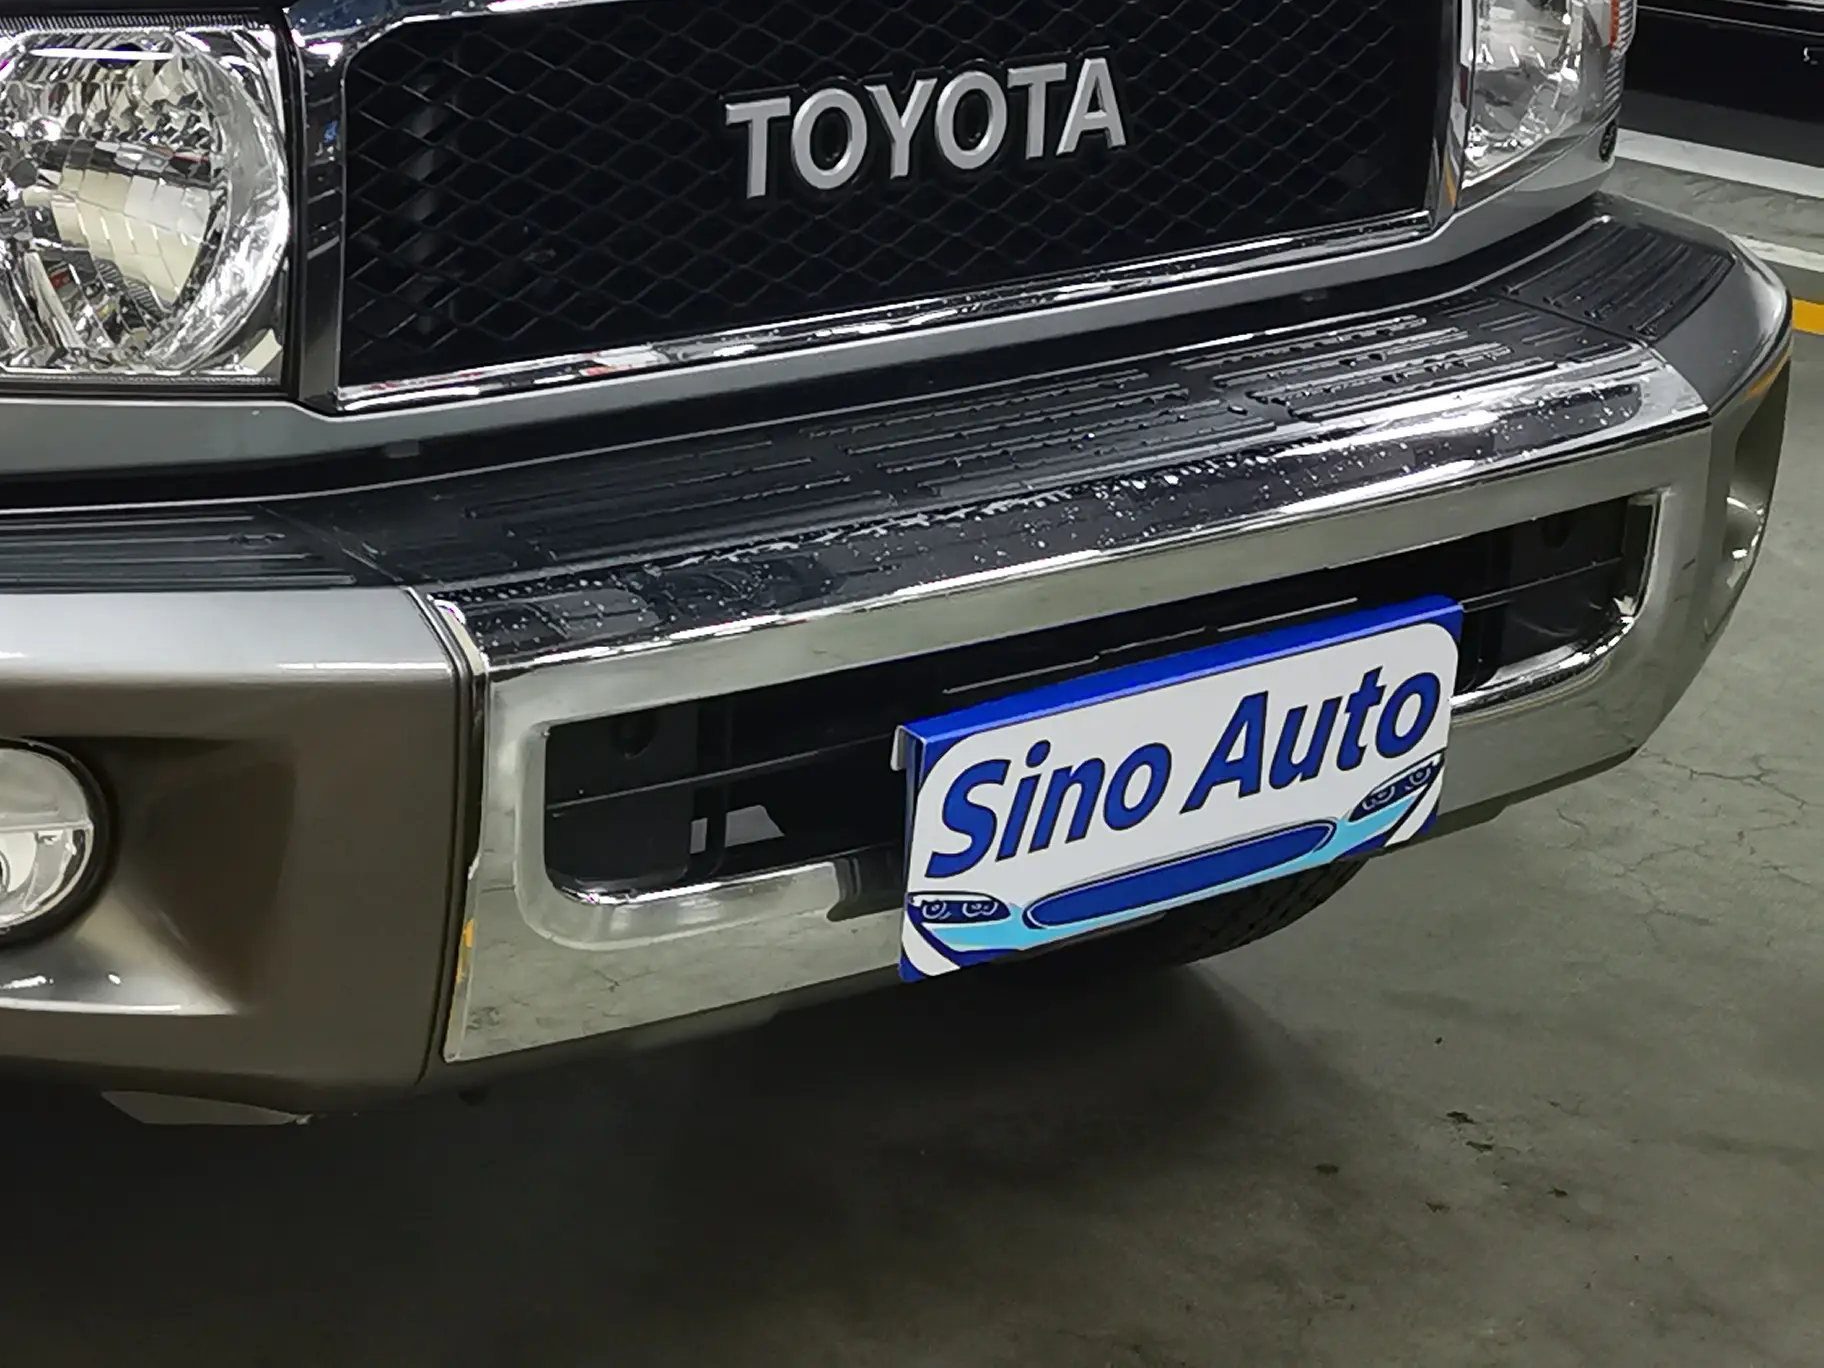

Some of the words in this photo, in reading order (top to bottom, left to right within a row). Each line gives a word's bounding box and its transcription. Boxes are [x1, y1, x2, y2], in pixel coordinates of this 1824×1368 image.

[725, 57, 1127, 199] TOYOTA
[924, 739, 1173, 879] Sino
[1179, 666, 1442, 815] Auto
